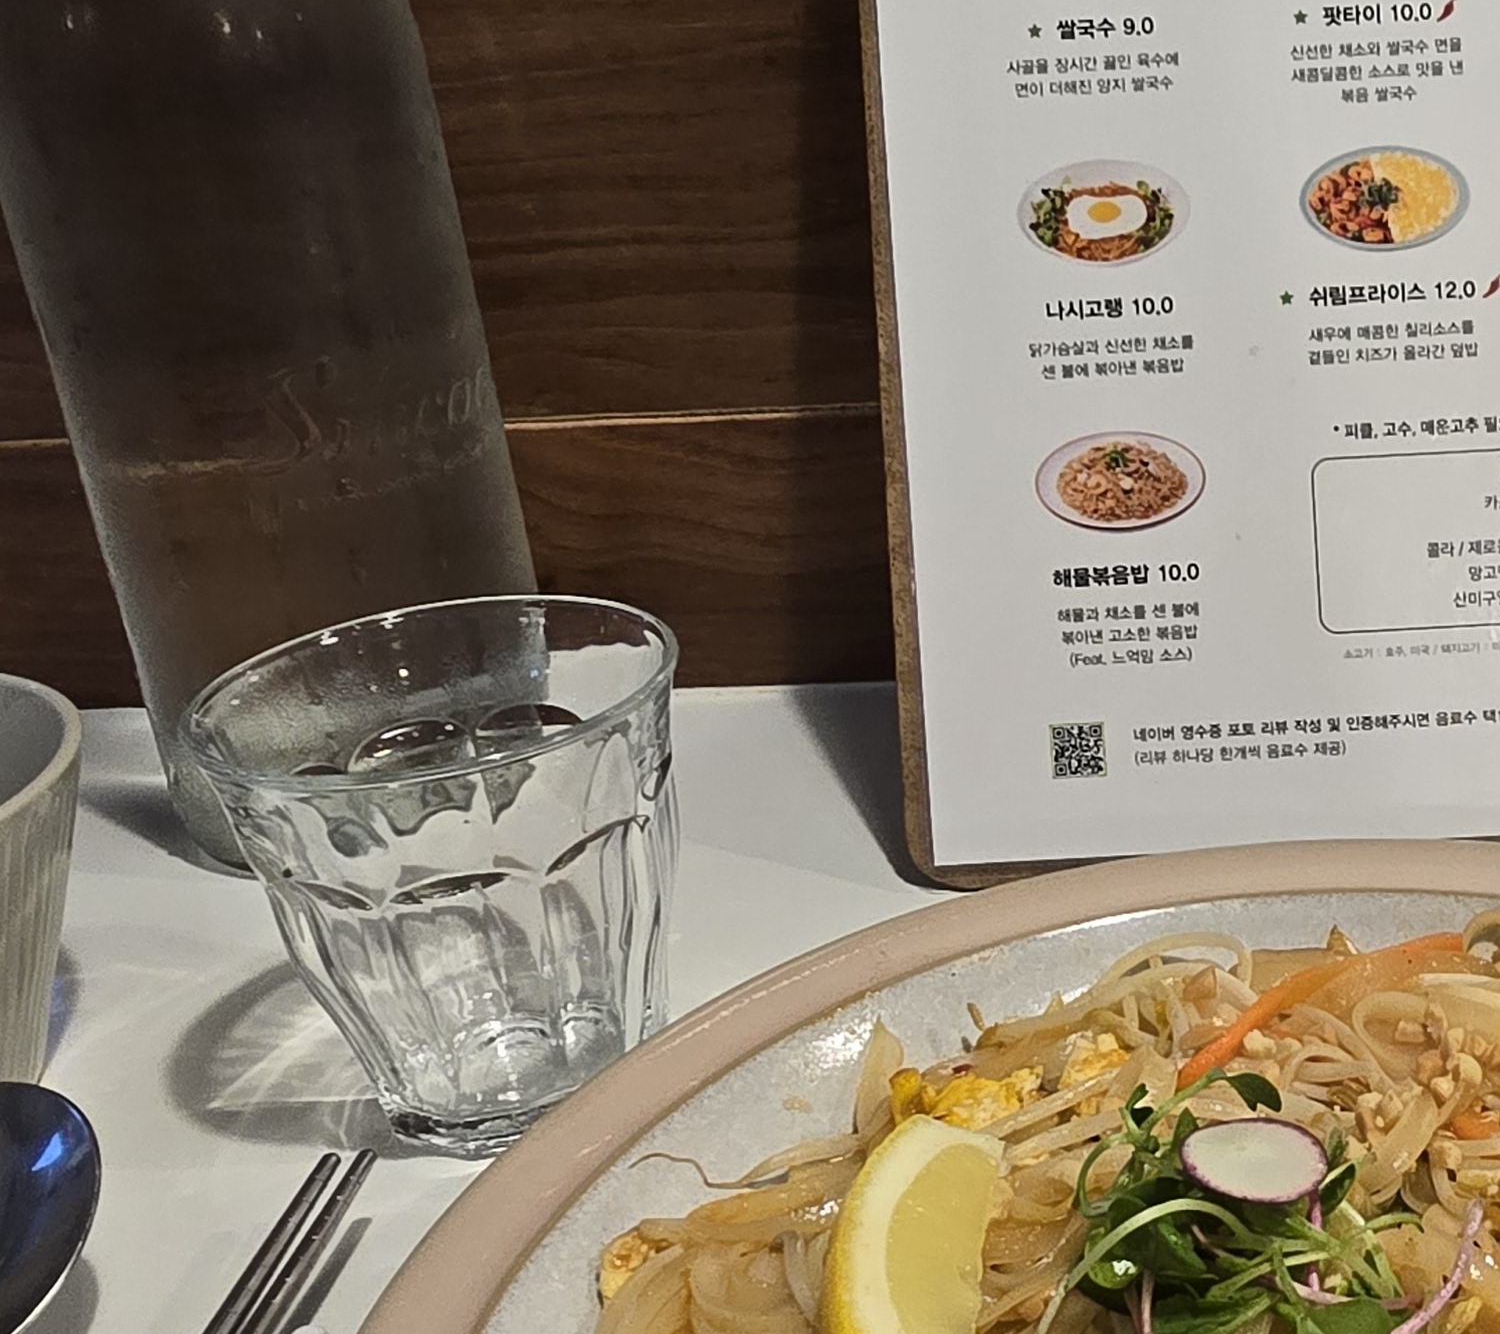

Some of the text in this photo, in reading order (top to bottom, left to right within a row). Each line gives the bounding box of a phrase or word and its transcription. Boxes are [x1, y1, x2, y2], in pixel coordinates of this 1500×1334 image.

[1322, 2, 1431, 26] 팟타이 10.0
[1056, 16, 1154, 39] 쌀국수 9.0
[1290, 36, 1461, 61] 신선한 채소와 쌀국수 면을
[1006, 57, 1048, 75] 사골을
[1054, 56, 1097, 73] 장시간
[1136, 51, 1178, 68] 육수에
[1291, 59, 1463, 83] 새콤달콤한 소스로 맛을 낸
[1014, 81, 1043, 98] 면이
[1049, 78, 1091, 95] 더해진
[1131, 75, 1173, 92] 쌀국수
[1341, 85, 1417, 103] 볶음 쌀국수
[1309, 280, 1475, 306] 쉬림프라이스 12.0
[1132, 296, 1173, 315] 10.0
[1308, 319, 1473, 342] 새우에 매콤한 칠리소스를
[1028, 334, 1193, 358] 닭가슴살과 신선한 채소를
[1355, 346, 1397, 362] 치즈가
[1403, 343, 1445, 360] 올라간
[1450, 341, 1478, 358] 덮밥
[1041, 357, 1184, 380] 센 불에 볶아낸 볶음밥
[1382, 420, 1416, 437] 고수,
[1420, 416, 1479, 435] 매운고추
[1426, 541, 1454, 558] 콜라
[1052, 562, 1199, 587] 해물볶음밥 10.0
[1057, 601, 1199, 623] 해물과 채소를 센 불에
[1061, 624, 1197, 645] 볶아낸 고소한 볶음밥
[1159, 646, 1192, 661] 소스)
[1132, 725, 1175, 741] 네이버
[1180, 723, 1221, 740] 영수증
[1226, 722, 1255, 736] 포토
[1260, 720, 1288, 735] 리뷰
[1293, 718, 1321, 733] 작성
[1326, 716, 1340, 732] 및
[1345, 712, 1429, 731] 인증해주시면
[1435, 710, 1477, 726] 음료수
[1134, 739, 1346, 766] (리뷰 하나당 한개씩 음료수 제공)
